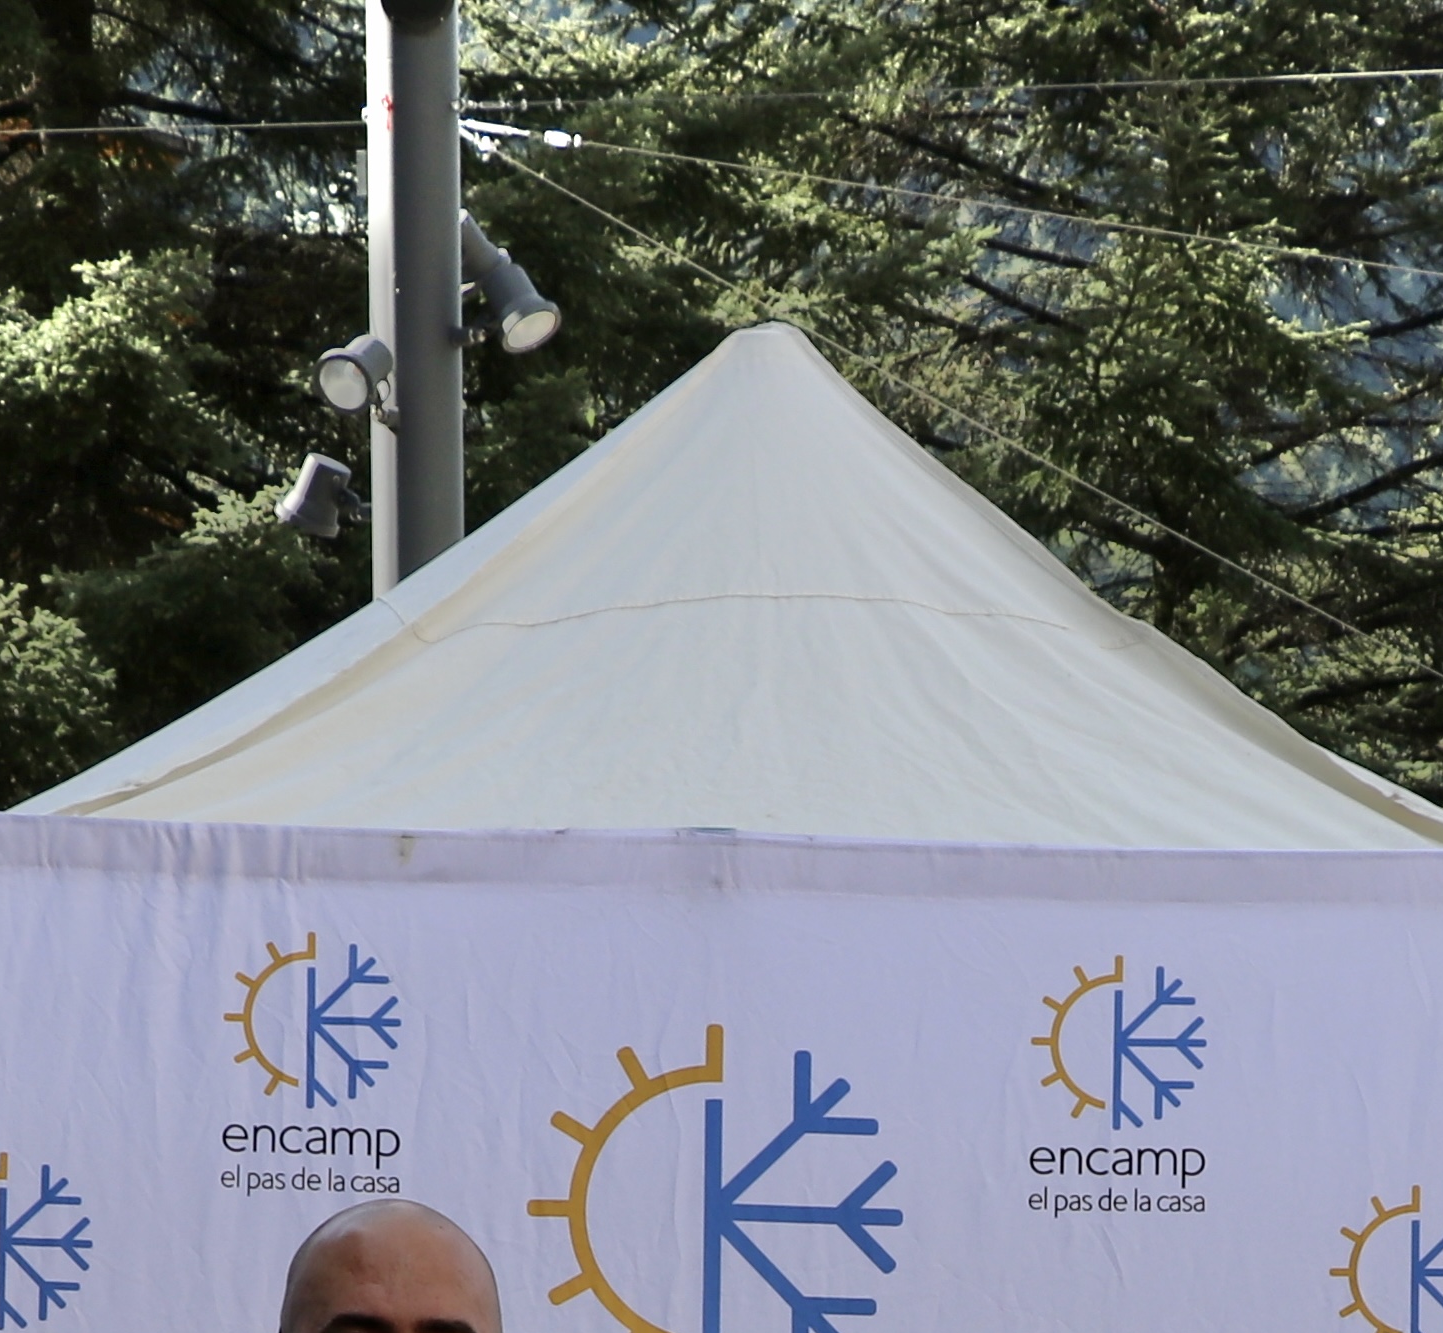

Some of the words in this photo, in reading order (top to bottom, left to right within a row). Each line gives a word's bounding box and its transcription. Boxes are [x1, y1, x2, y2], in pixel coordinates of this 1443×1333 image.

[221, 1123, 401, 1170] encamp
[220, 1164, 240, 1188] el
[246, 1172, 286, 1197] pas
[291, 1166, 322, 1192] de
[328, 1167, 346, 1193] la
[350, 1175, 400, 1194] casa
[1029, 1146, 1206, 1190] encamp
[1028, 1186, 1048, 1211] el
[1054, 1194, 1093, 1219] pas
[1097, 1187, 1128, 1212] de
[1134, 1188, 1152, 1213] la
[1156, 1195, 1206, 1213] casa
